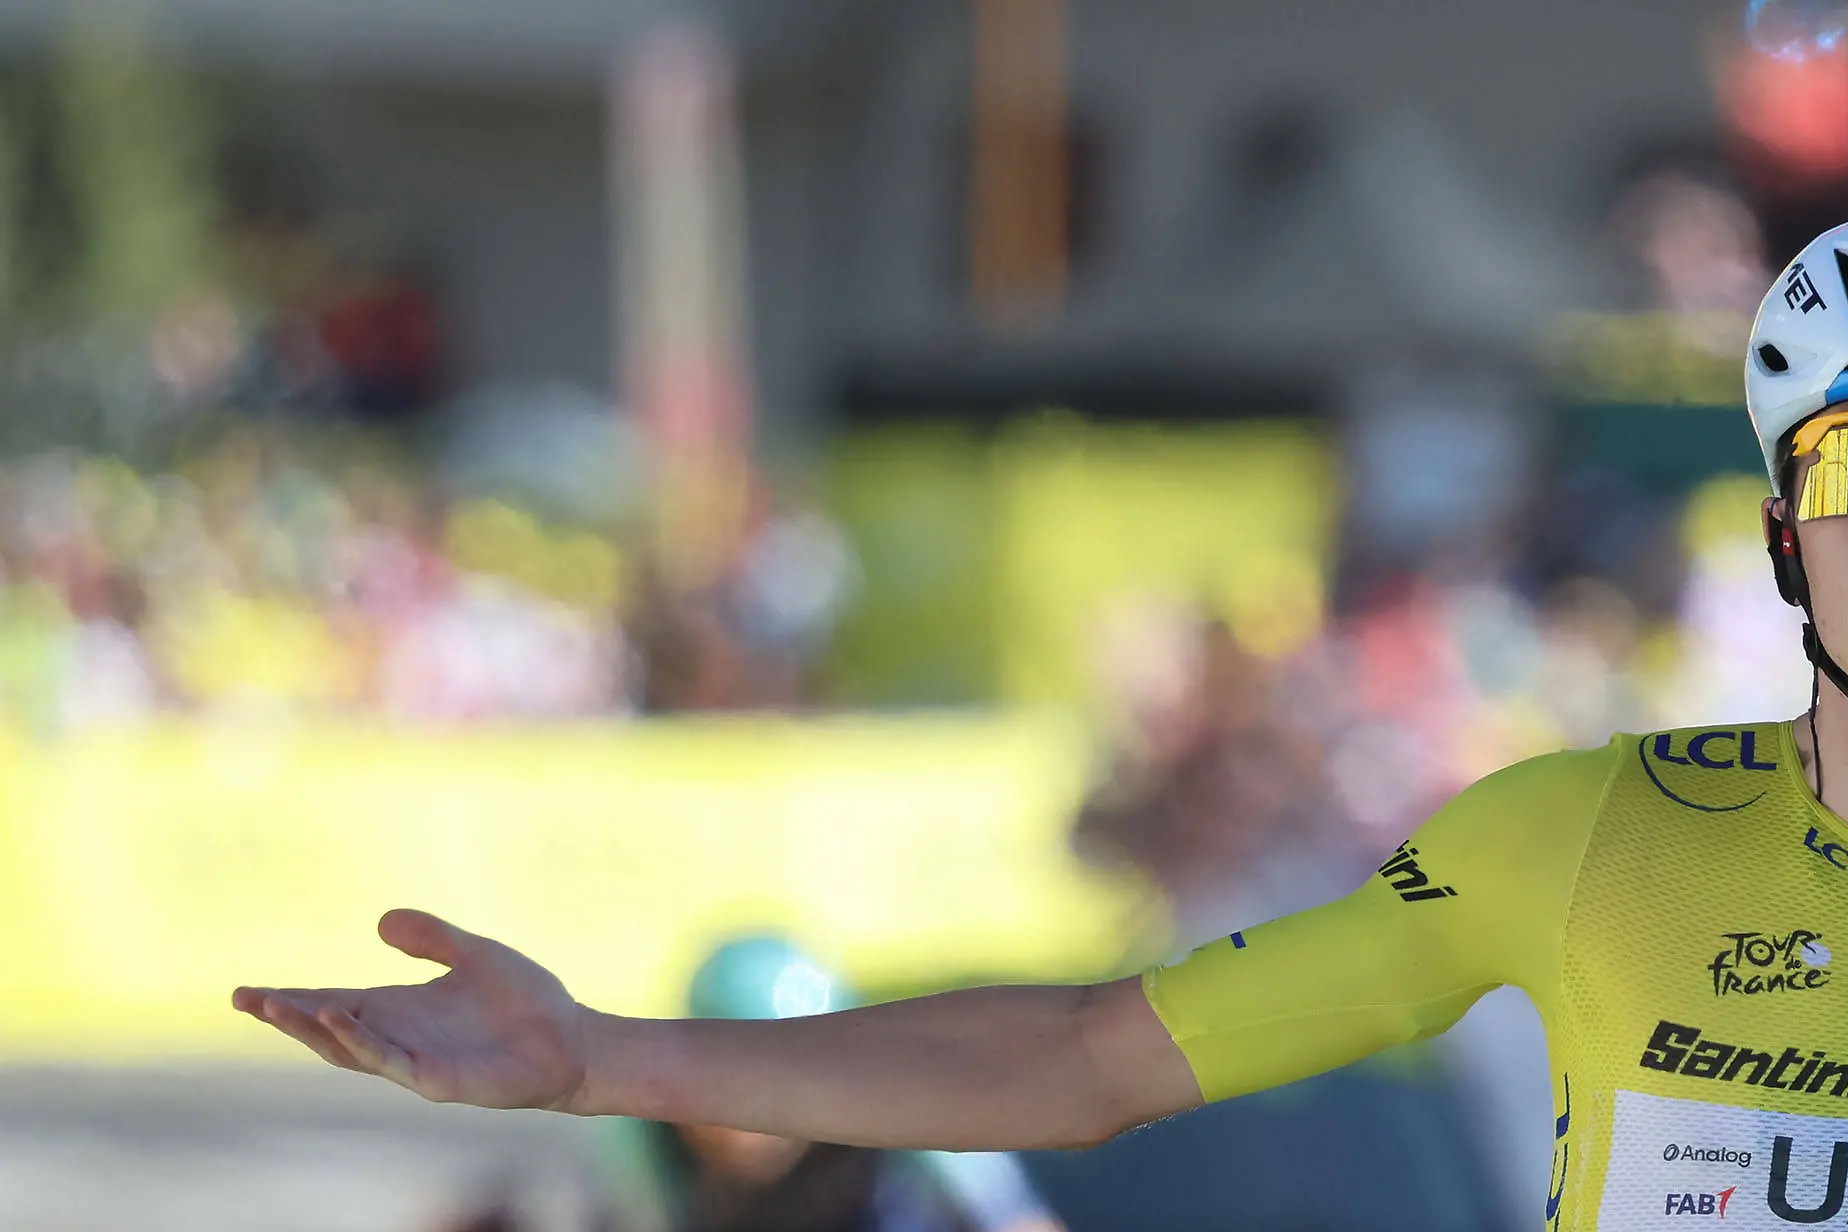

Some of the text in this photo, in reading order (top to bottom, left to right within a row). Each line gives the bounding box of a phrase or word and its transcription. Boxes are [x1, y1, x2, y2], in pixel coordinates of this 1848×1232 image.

[1653, 730, 1777, 771] LCL
[1784, 955, 1802, 970] de
[1680, 1144, 1752, 1168] Analog
